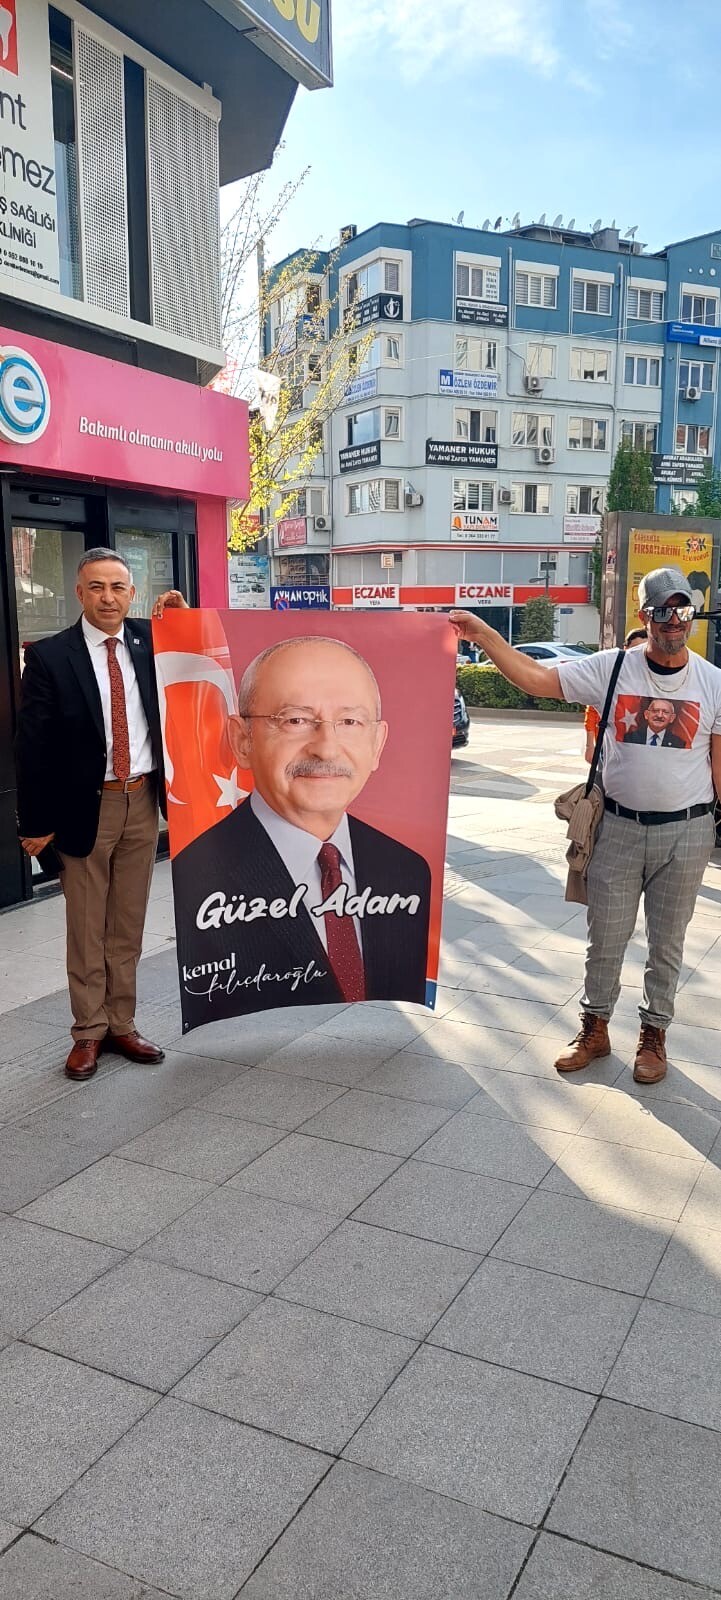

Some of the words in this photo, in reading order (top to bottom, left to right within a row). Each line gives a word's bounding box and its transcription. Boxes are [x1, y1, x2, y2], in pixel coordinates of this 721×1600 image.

[0, 145, 56, 195] mez
[10, 200, 56, 233] SAĞLIĞI
[440, 375, 451, 386] M
[79, 416, 128, 443] Bakımlı
[129, 430, 174, 452] olmanın
[175, 440, 201, 459] akıllı
[201, 445, 224, 463] yolu
[428, 444, 467, 454] YAMANER
[468, 446, 496, 456] HUKUK
[468, 456, 496, 464] YAMANER
[463, 515, 498, 525] TUNAM
[384, 556, 392, 567] E
[303, 589, 329, 605] optik
[354, 586, 396, 599] ECZANE
[459, 586, 511, 599] ECZANE
[195, 883, 308, 931] Güzel
[312, 883, 421, 919] Adam
[183, 952, 236, 982] kemal
